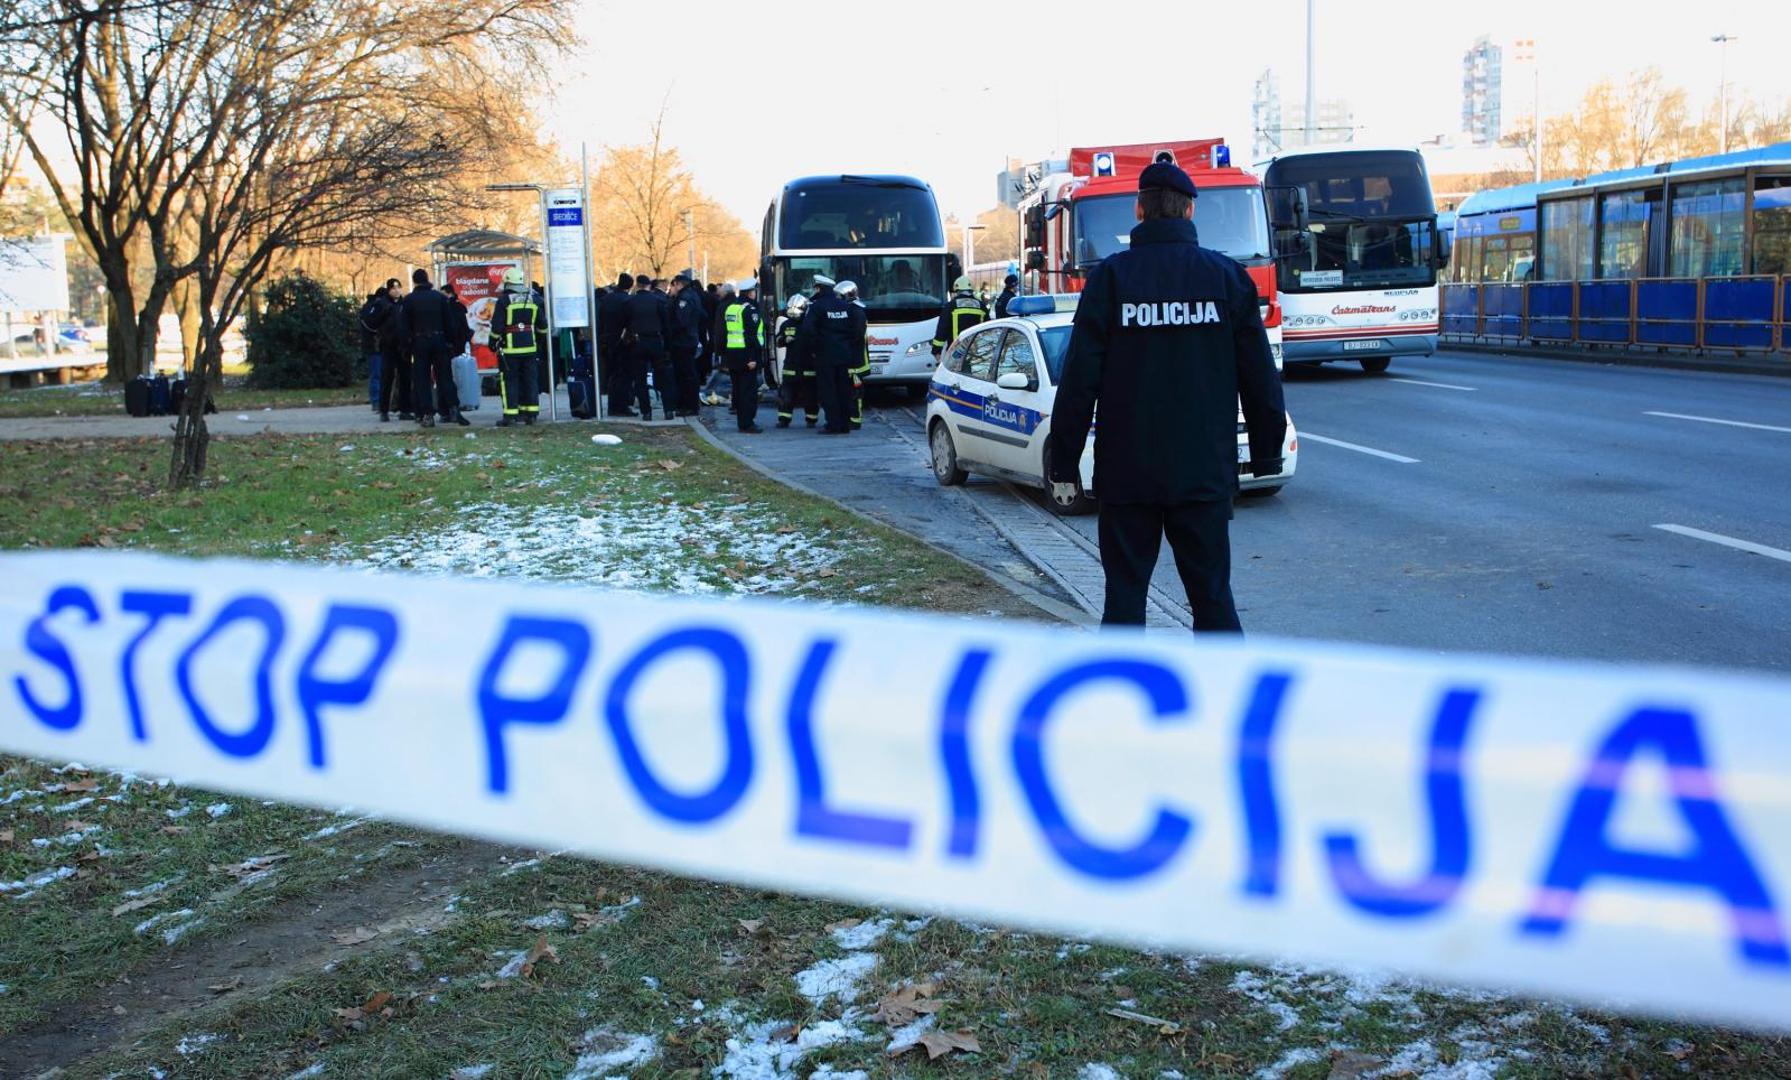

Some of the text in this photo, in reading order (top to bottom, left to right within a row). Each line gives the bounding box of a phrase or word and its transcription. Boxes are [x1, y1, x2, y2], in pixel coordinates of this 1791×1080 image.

[1121, 301, 1220, 327] POLICIJA
[985, 404, 1018, 424] POLICIJA
[14, 584, 1791, 970] STOP POLICIJA
